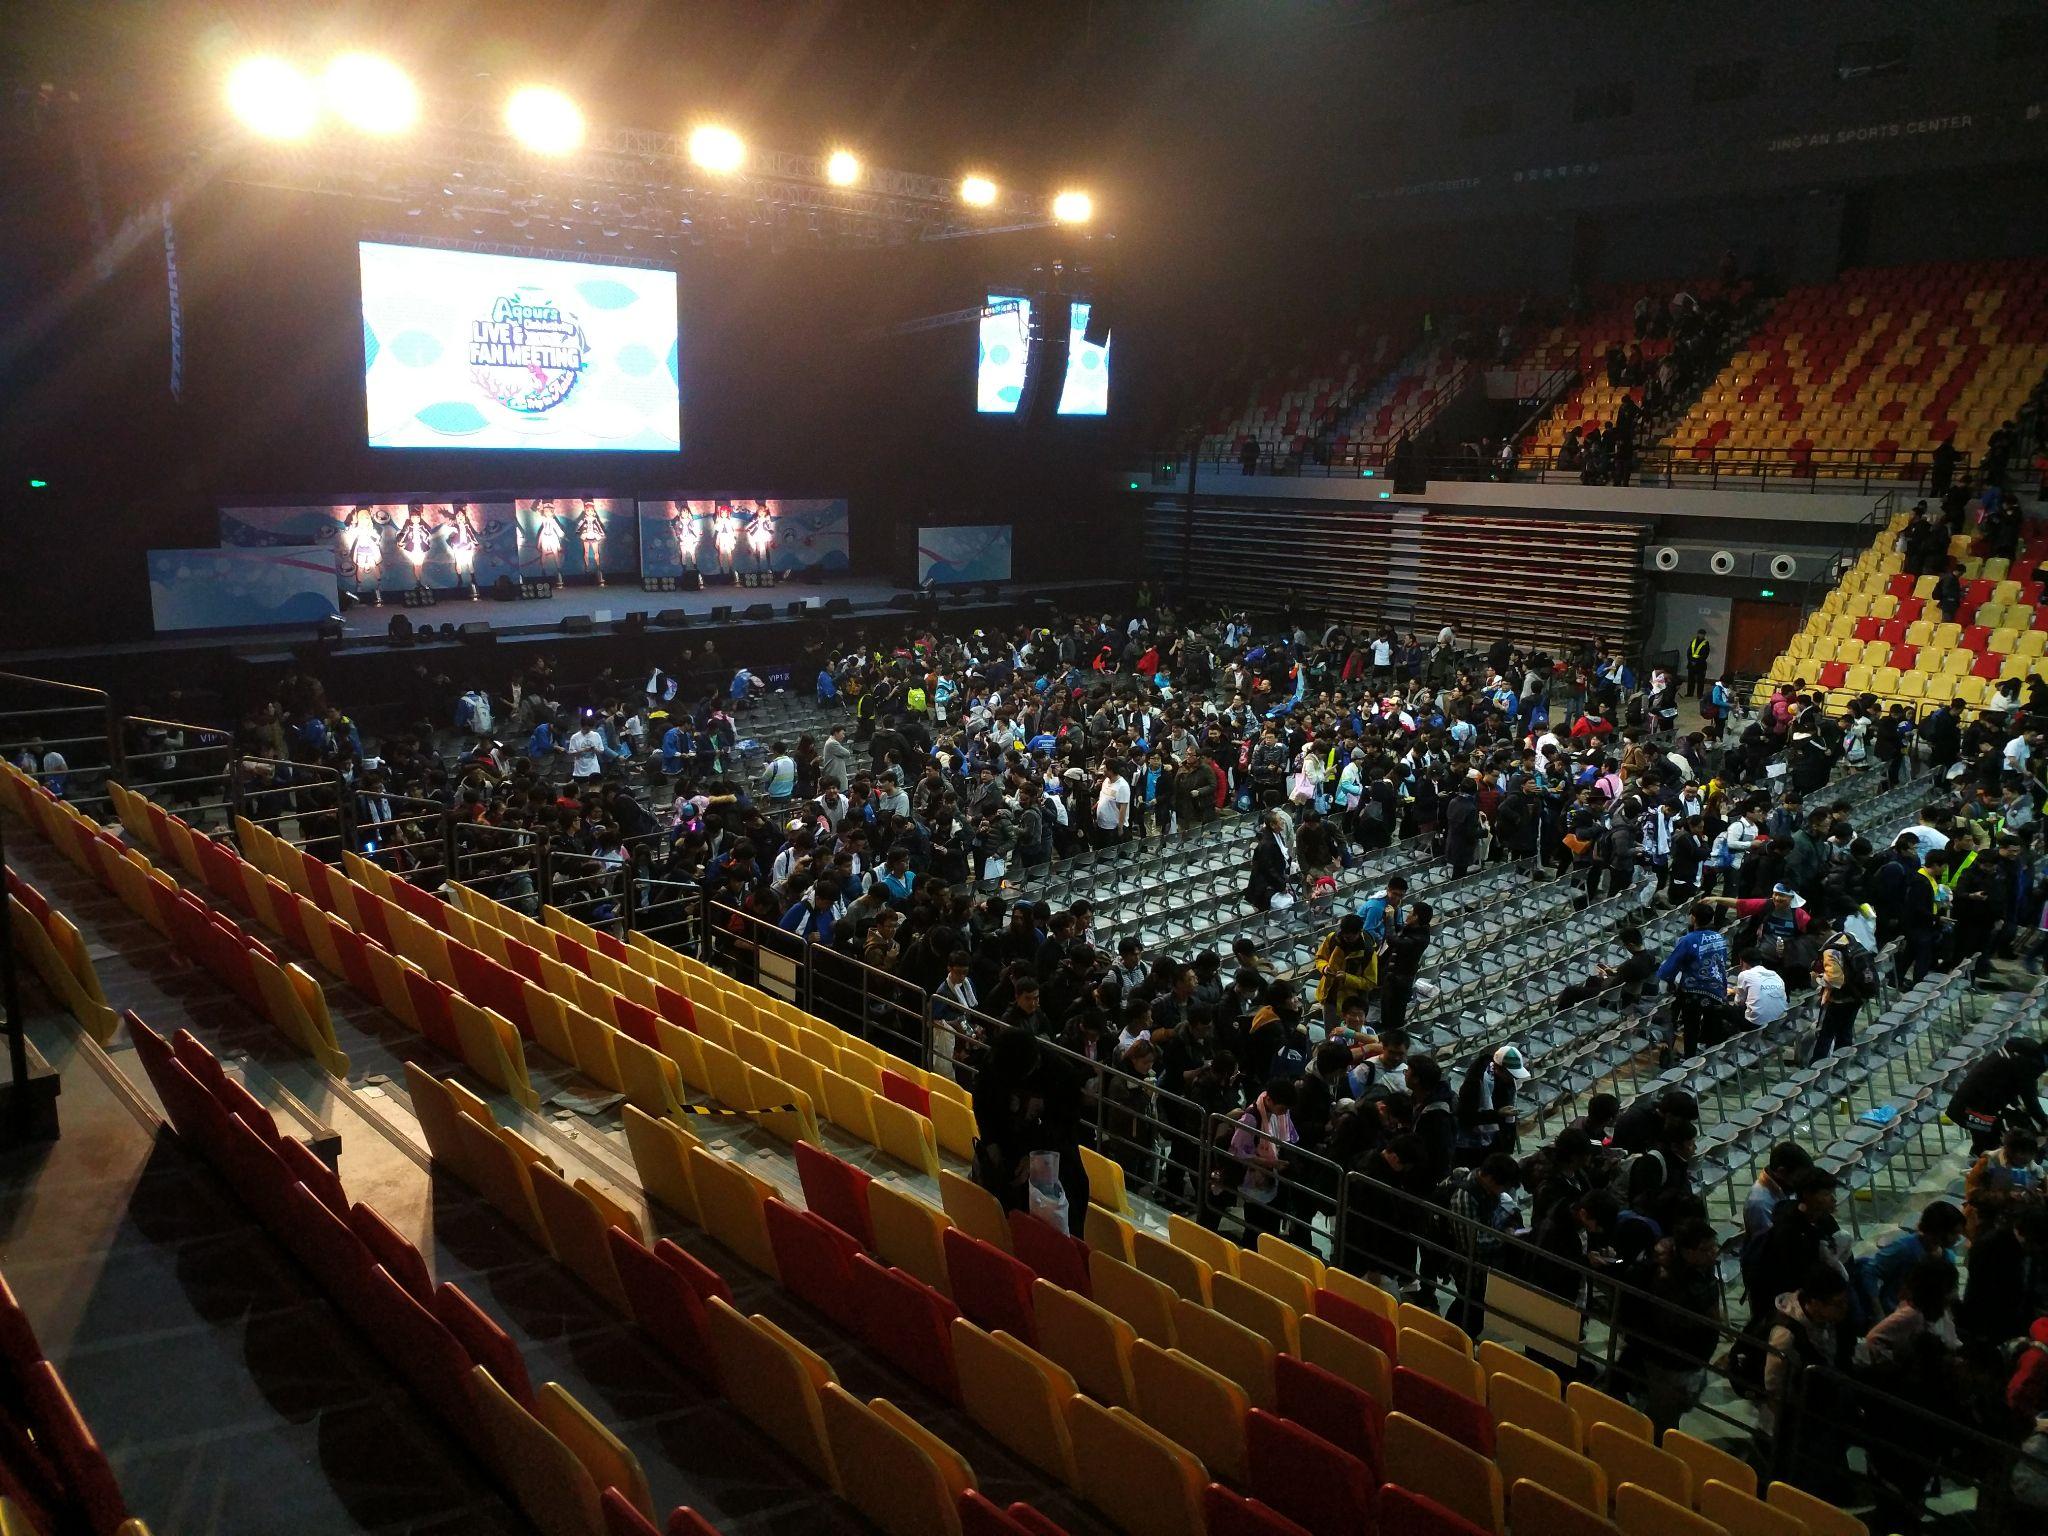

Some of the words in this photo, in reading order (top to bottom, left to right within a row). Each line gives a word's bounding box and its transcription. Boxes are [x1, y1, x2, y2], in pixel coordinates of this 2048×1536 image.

[1767, 133, 1829, 152] JING'AN
[1836, 123, 1901, 145] SPORTS
[1906, 114, 1972, 135] CENTER
[492, 297, 560, 327] Aqours
[472, 320, 513, 345] LIVE
[469, 342, 506, 366] FAN
[506, 344, 582, 370] MEETING
